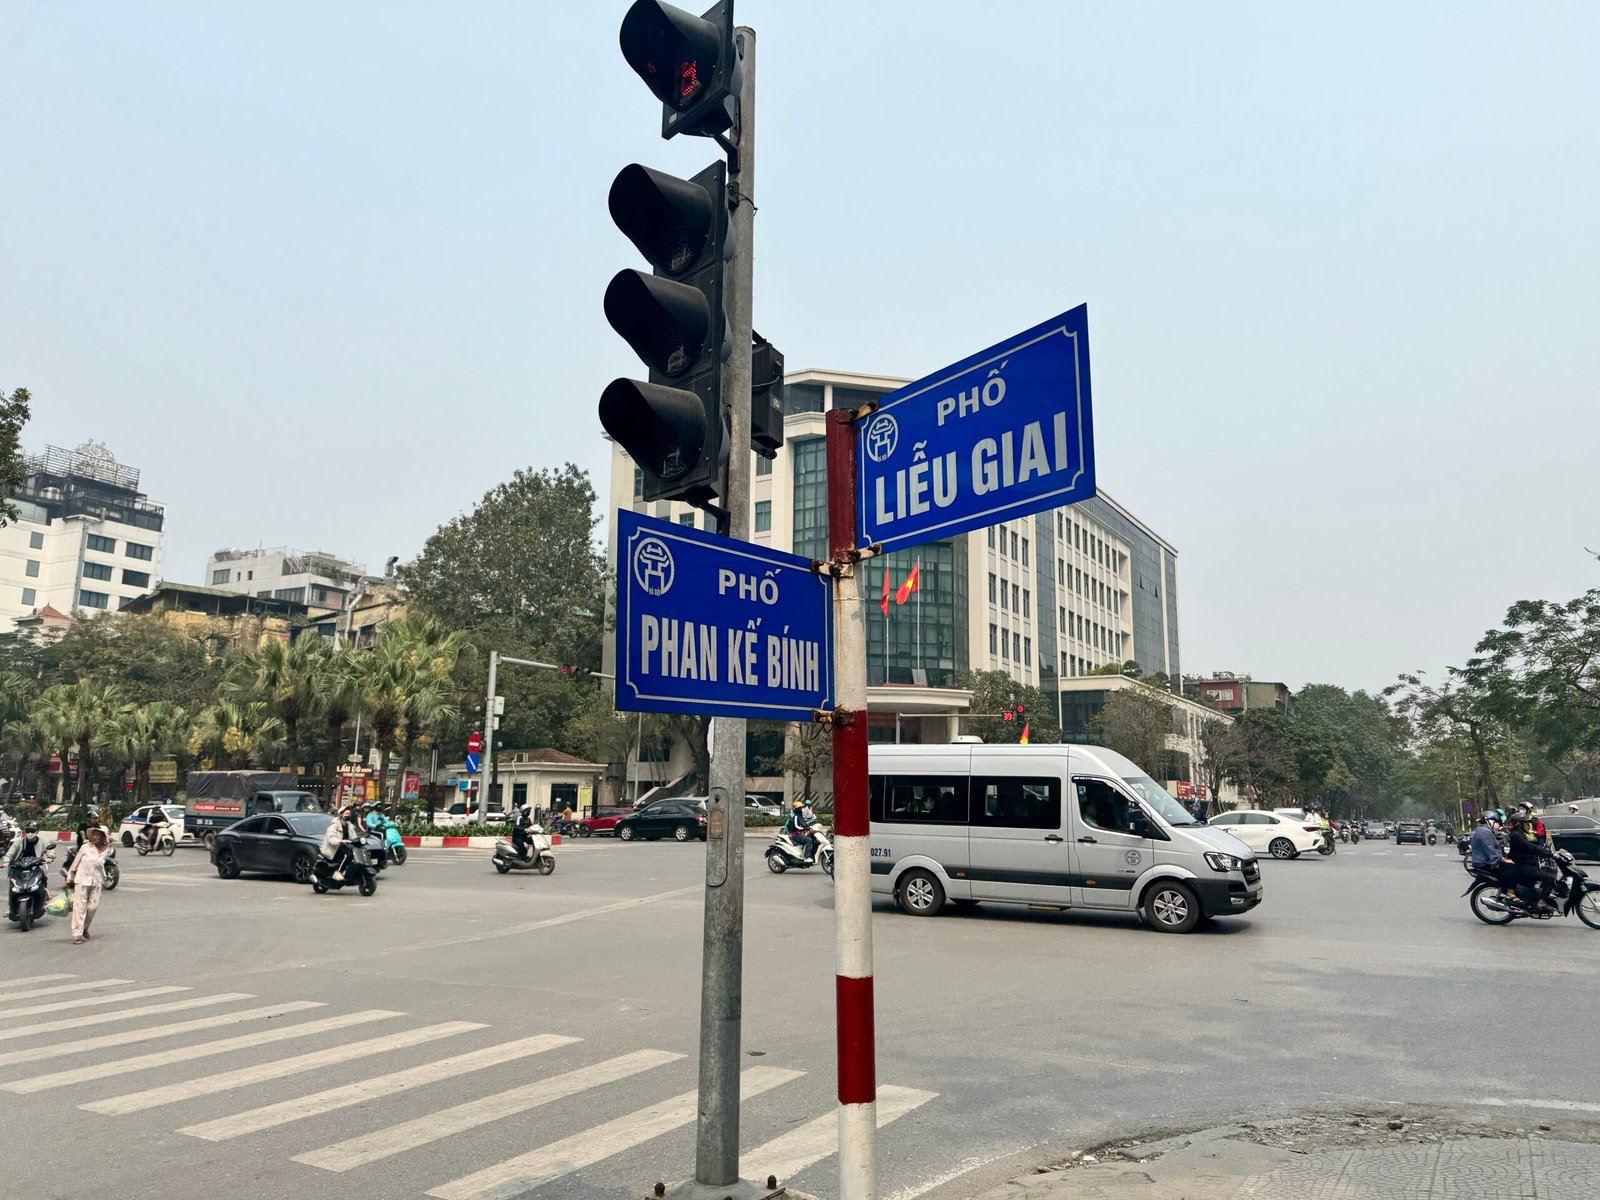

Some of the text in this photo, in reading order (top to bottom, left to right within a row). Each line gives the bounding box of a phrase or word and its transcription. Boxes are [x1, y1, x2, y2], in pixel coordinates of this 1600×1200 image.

[936, 360, 1009, 427] PHỐ
[875, 411, 1069, 526] LIỄU GIAI
[718, 568, 782, 605] PHỐ
[641, 614, 819, 692] PHAN KẾ BÍNH
[870, 848, 891, 857] 027.91
